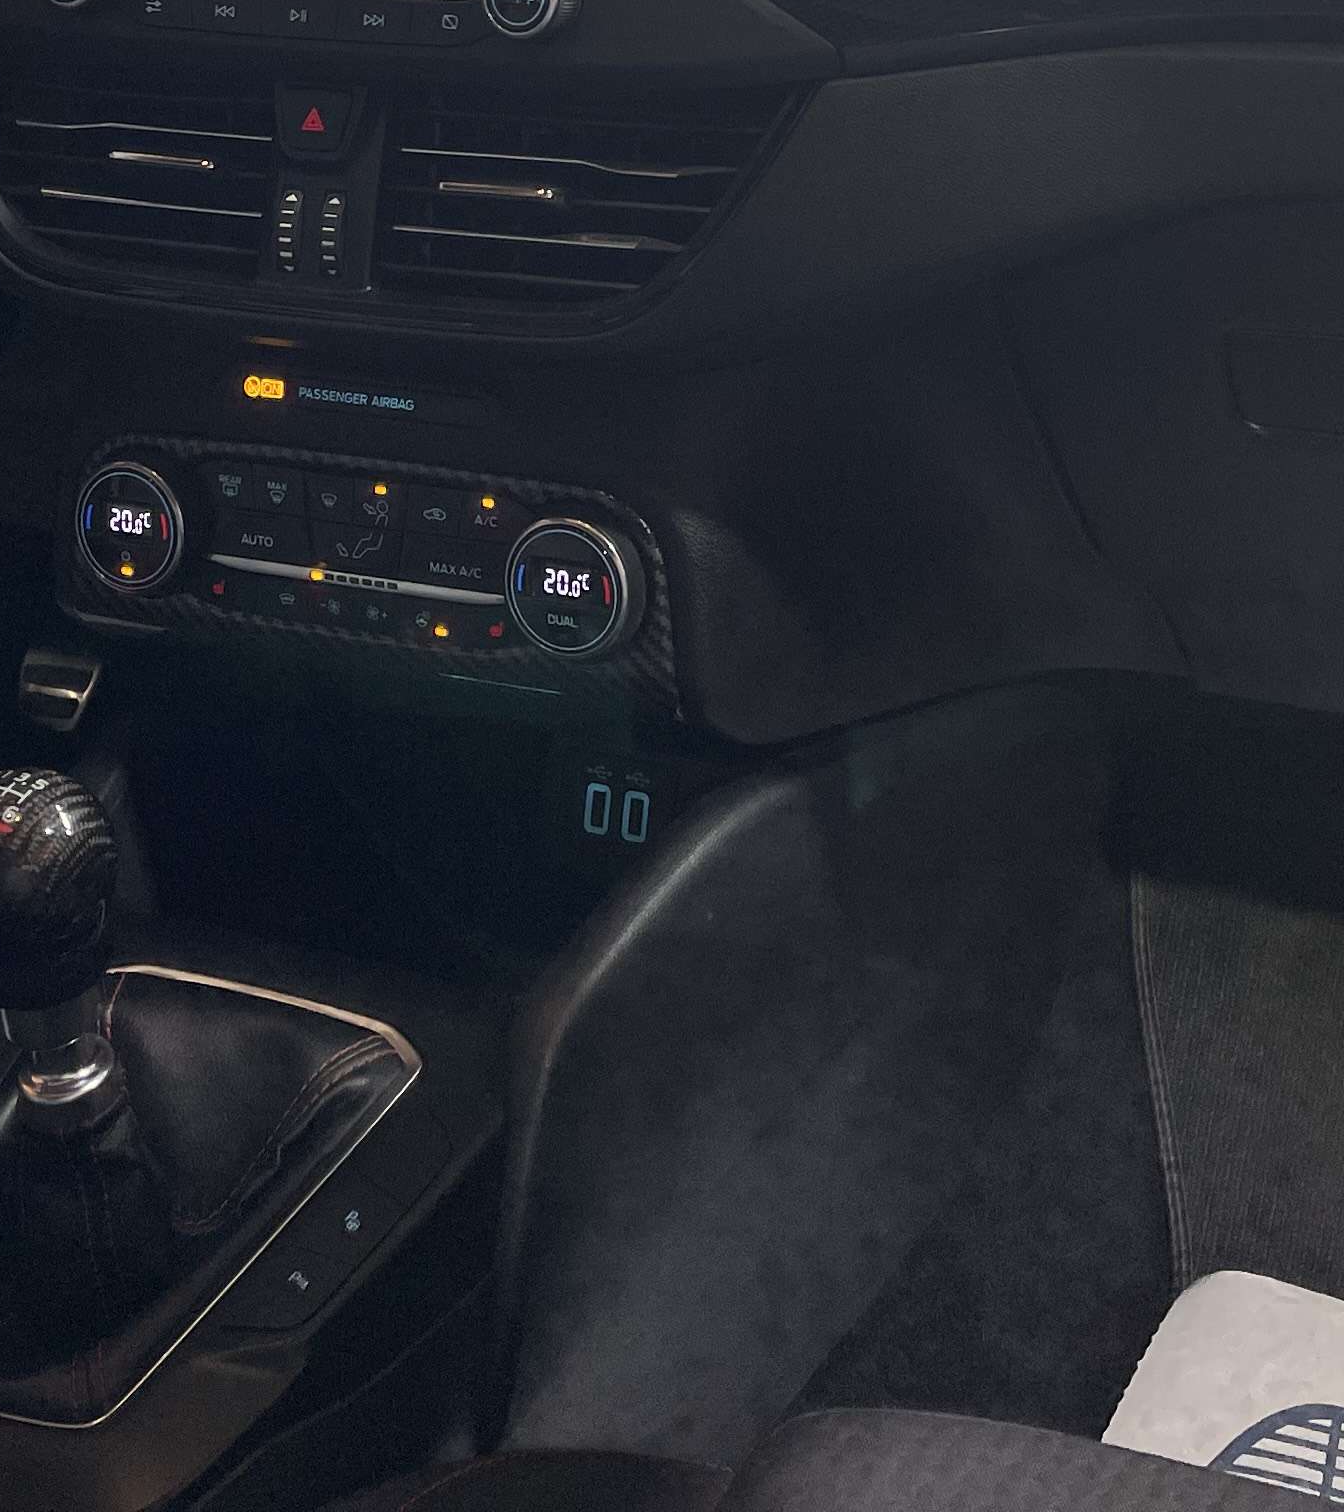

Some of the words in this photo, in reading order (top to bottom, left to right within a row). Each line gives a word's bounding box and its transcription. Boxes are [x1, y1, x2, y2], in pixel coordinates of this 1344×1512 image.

[298, 387, 368, 406] PASSENGER
[371, 395, 415, 411] AIRBAG
[218, 474, 242, 485] REAR
[267, 481, 288, 491] MAX
[474, 514, 499, 528] A/C
[241, 533, 274, 547] AUTO
[429, 561, 456, 575] MAX
[459, 566, 483, 579] A/C
[547, 613, 578, 628] DUAL
